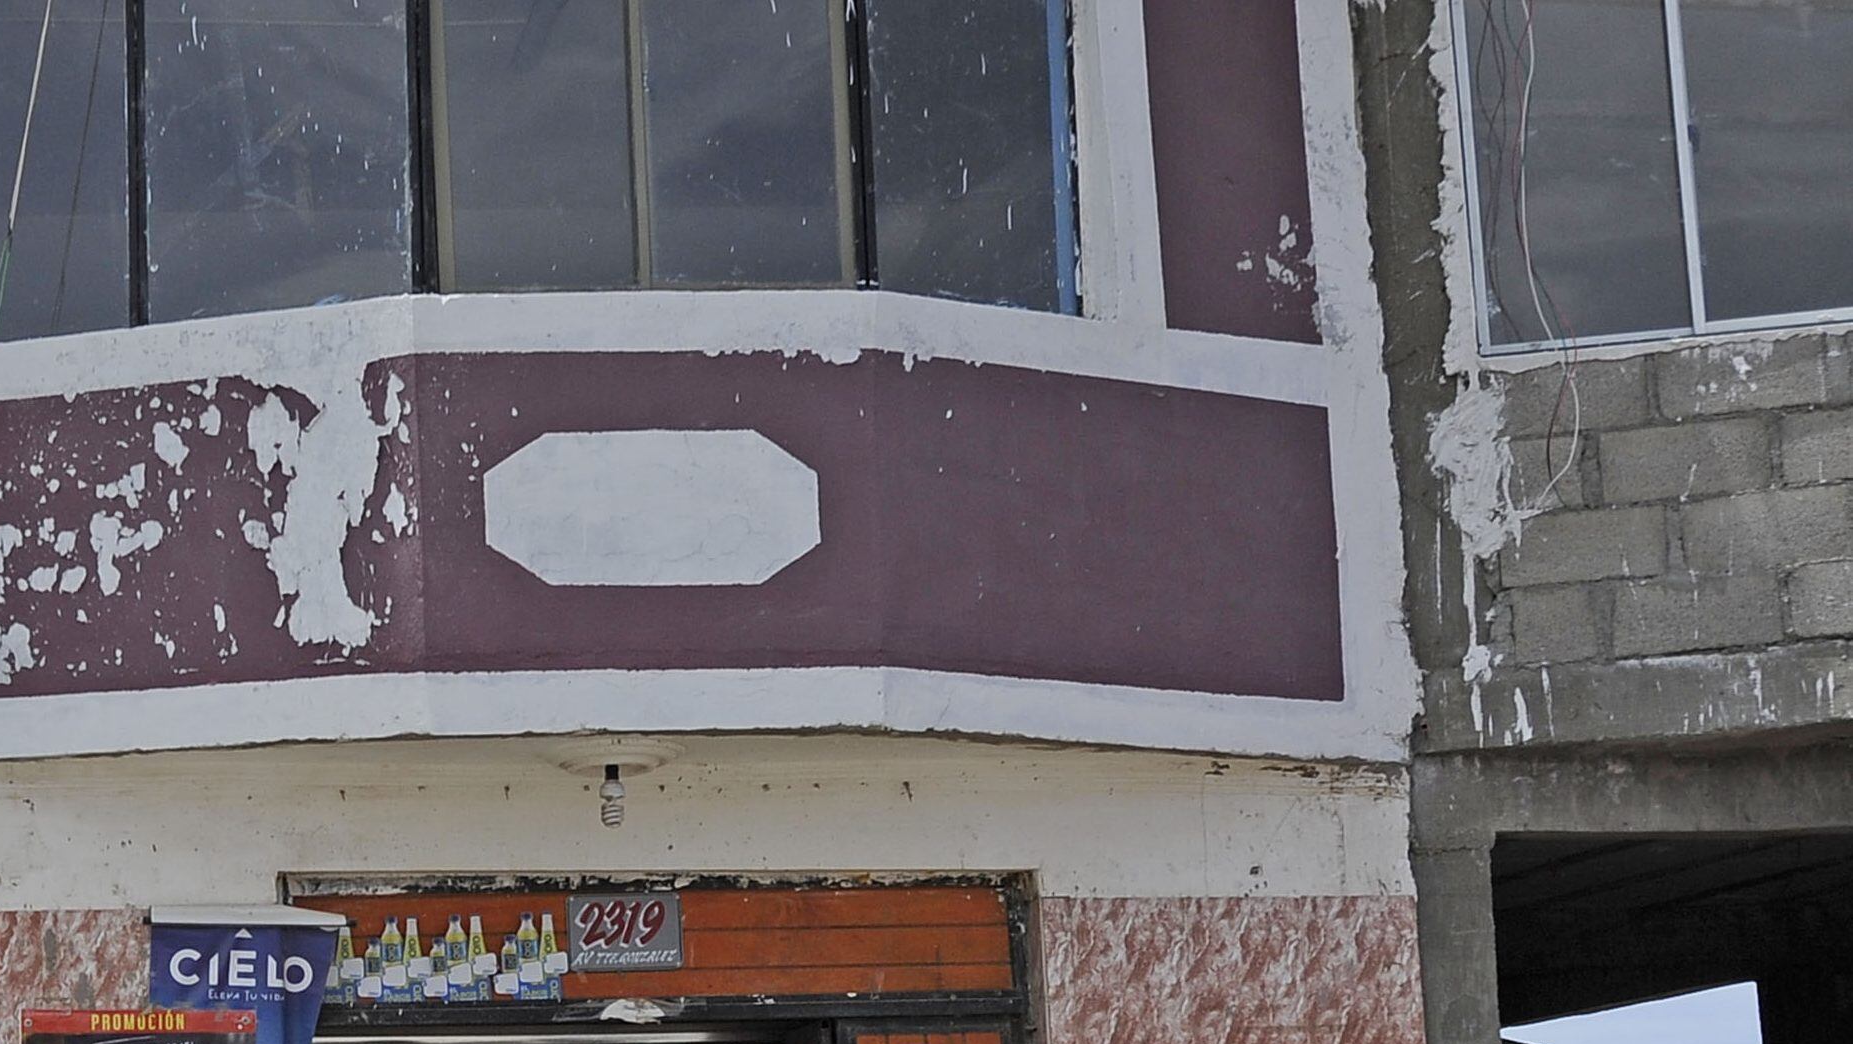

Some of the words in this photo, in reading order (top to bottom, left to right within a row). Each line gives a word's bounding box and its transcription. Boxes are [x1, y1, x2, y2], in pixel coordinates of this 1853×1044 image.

[575, 900, 665, 950] 2319
[571, 951, 594, 965] AV
[91, 1010, 185, 1031] PROMOCIÓN
